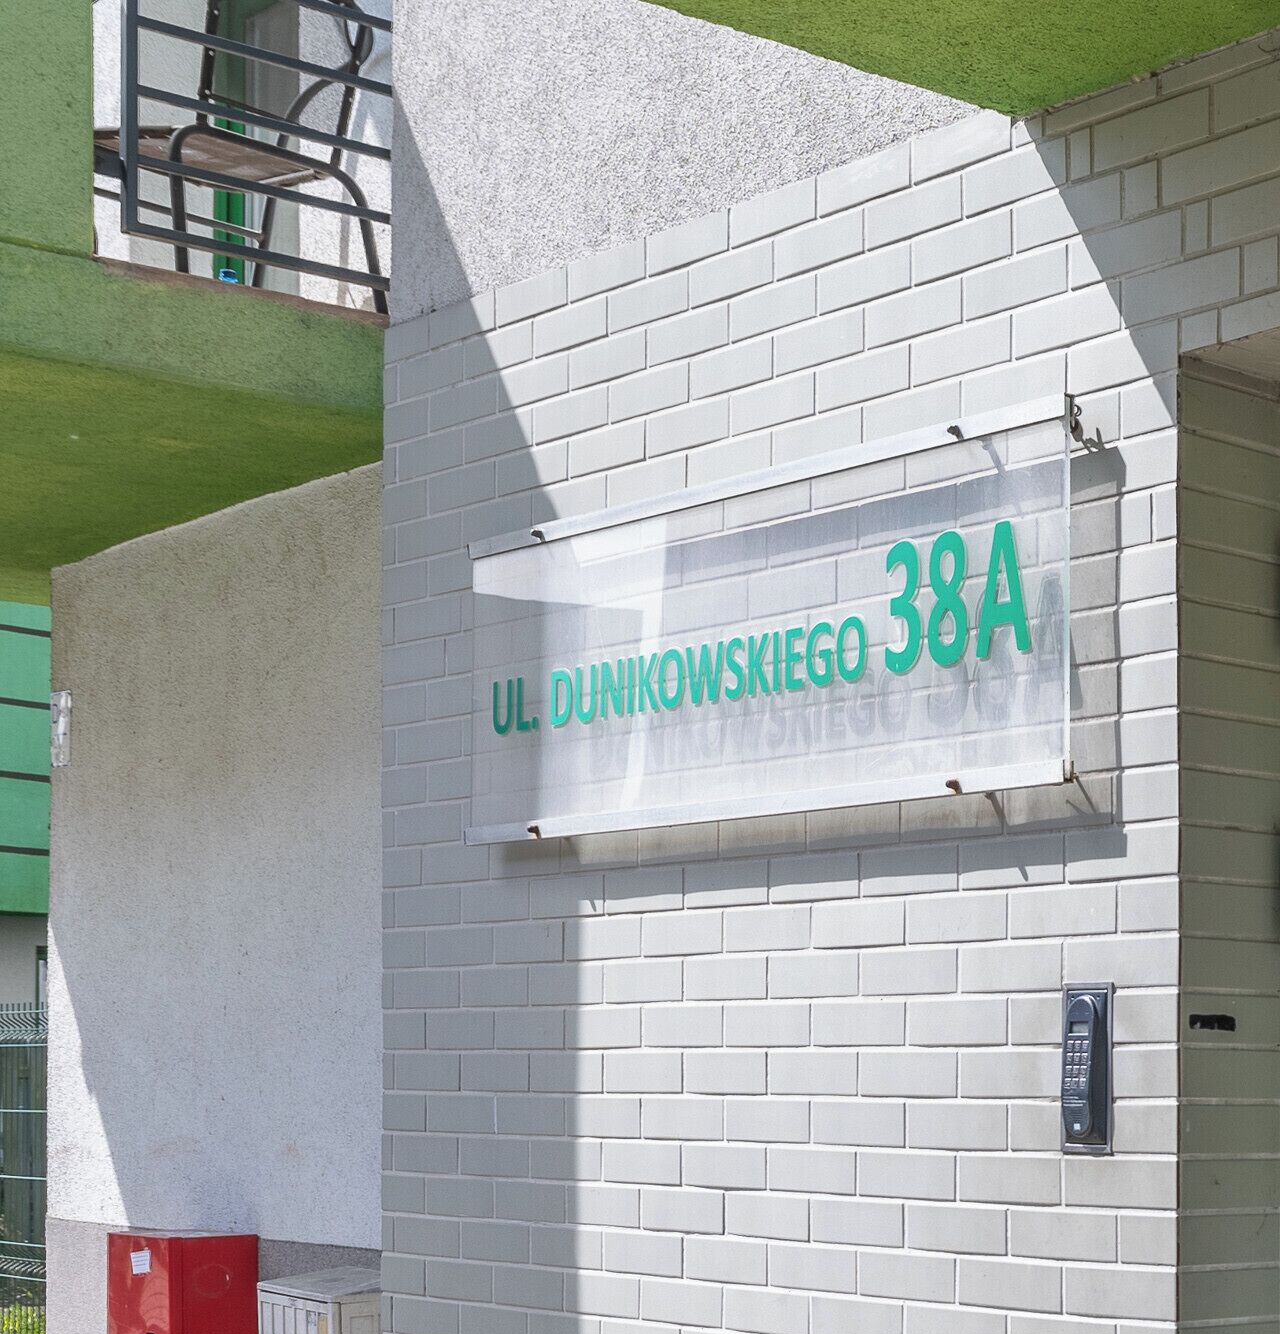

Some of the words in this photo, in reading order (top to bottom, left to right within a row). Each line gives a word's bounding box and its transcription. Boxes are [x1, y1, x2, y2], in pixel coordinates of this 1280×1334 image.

[492, 676, 540, 736] UL.
[550, 615, 867, 729] DUNIKOWSKIEGO
[884, 519, 1032, 675] 38A
